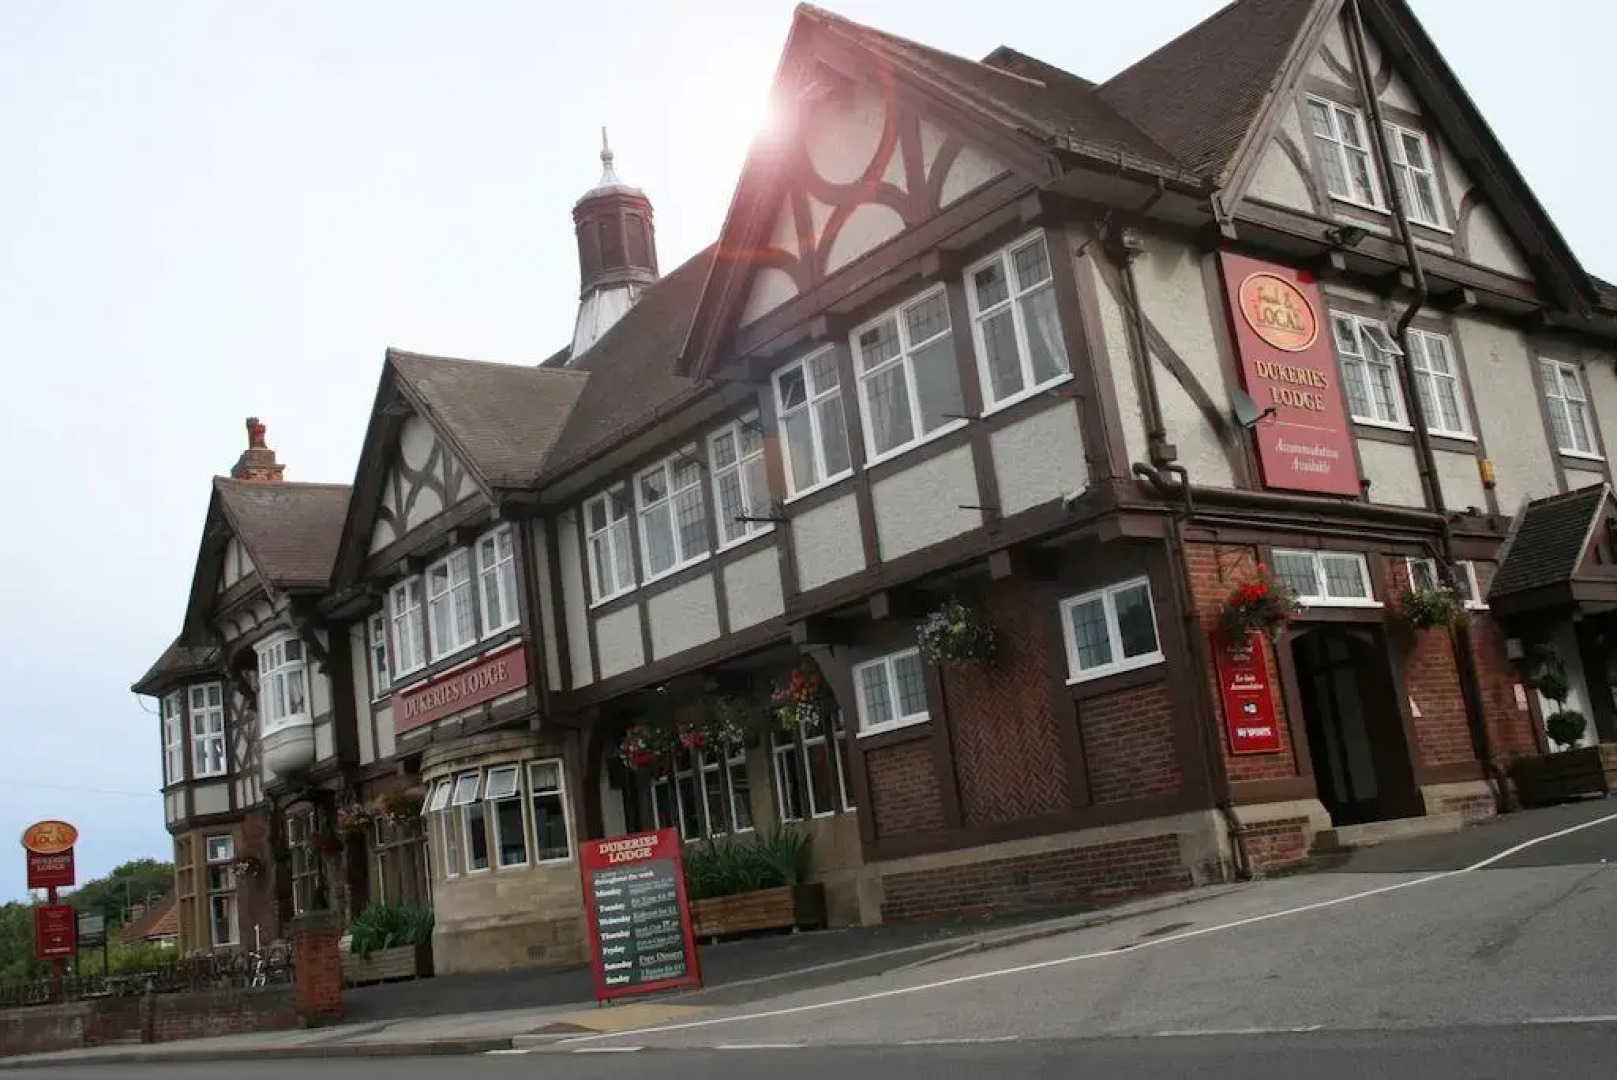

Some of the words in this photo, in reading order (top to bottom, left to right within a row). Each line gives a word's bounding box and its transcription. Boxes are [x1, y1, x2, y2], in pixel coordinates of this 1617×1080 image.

[1255, 303, 1305, 330] LOCAL
[1256, 361, 1328, 389] DUKERIES
[1269, 386, 1326, 412] LODGE
[404, 682, 461, 719] DUKERIES
[462, 661, 510, 695] LODGE
[598, 835, 659, 855] DUKERIES
[608, 847, 653, 863] LODGE
